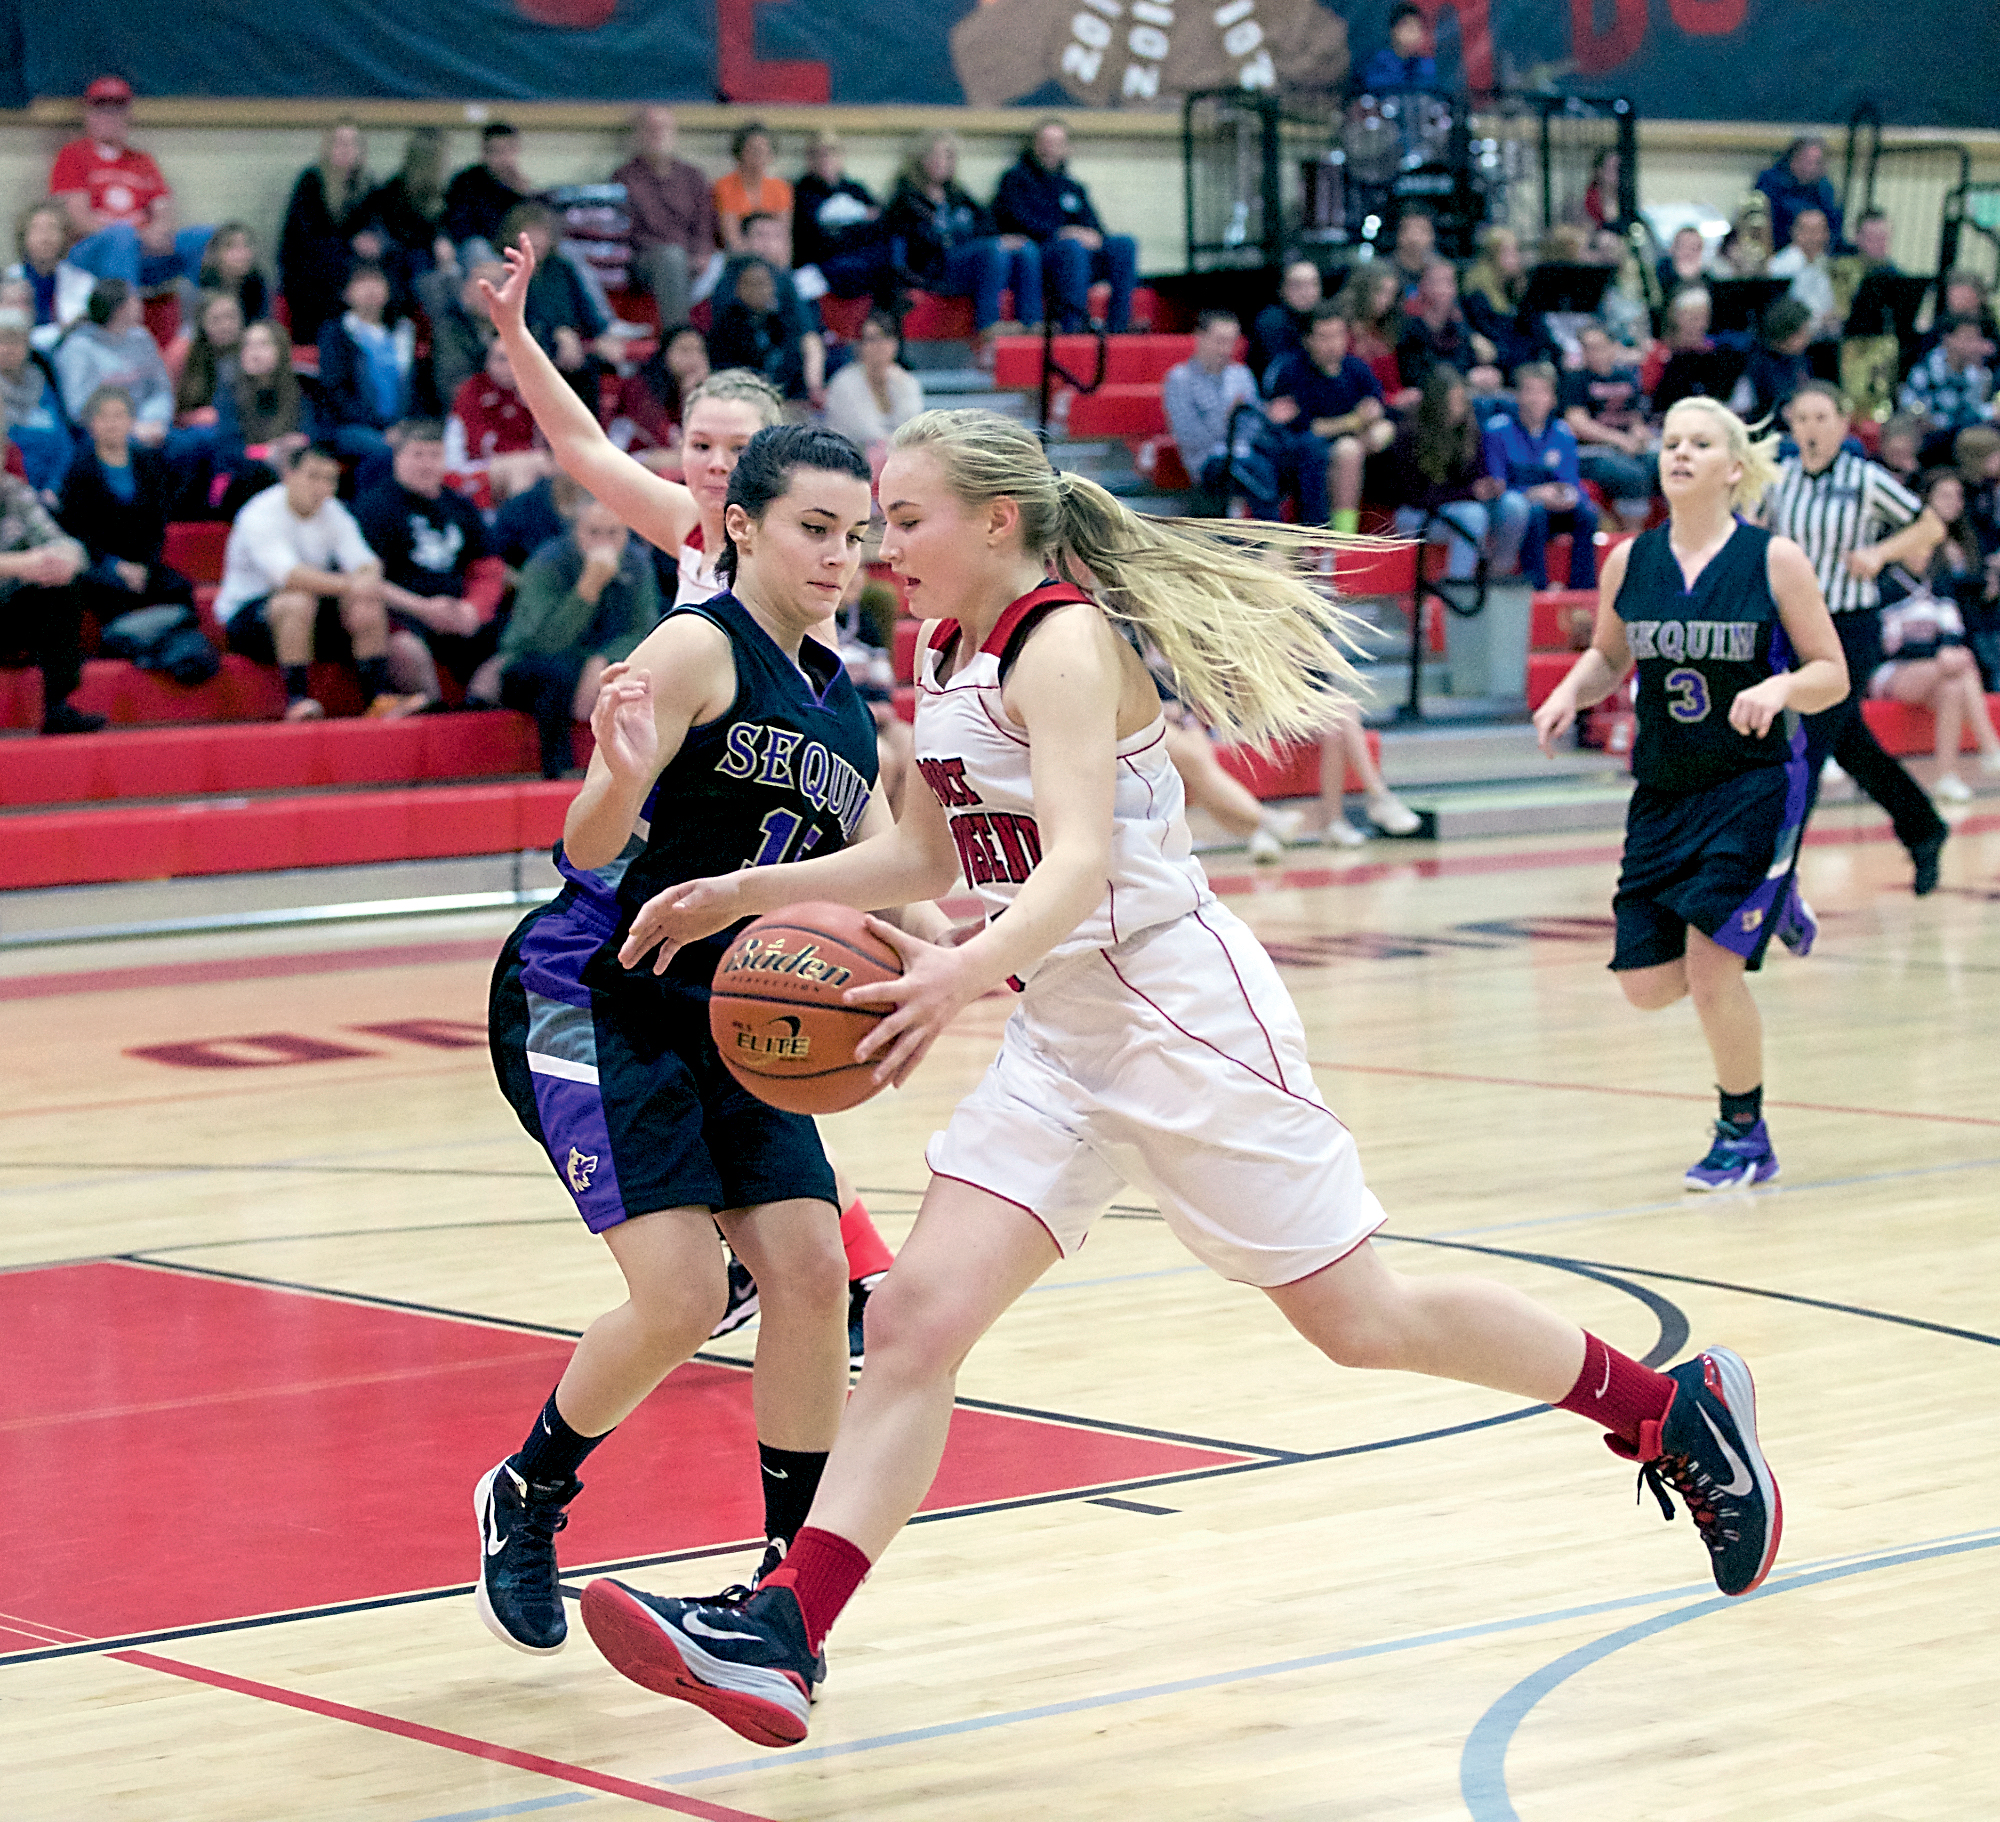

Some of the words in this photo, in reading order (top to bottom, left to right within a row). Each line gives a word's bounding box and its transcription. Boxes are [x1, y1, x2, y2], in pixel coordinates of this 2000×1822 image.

[1121, 0, 1176, 98] 201
[1665, 667, 1712, 723] 3
[739, 806, 825, 870] 1
[736, 1031, 811, 1058] ELITE
